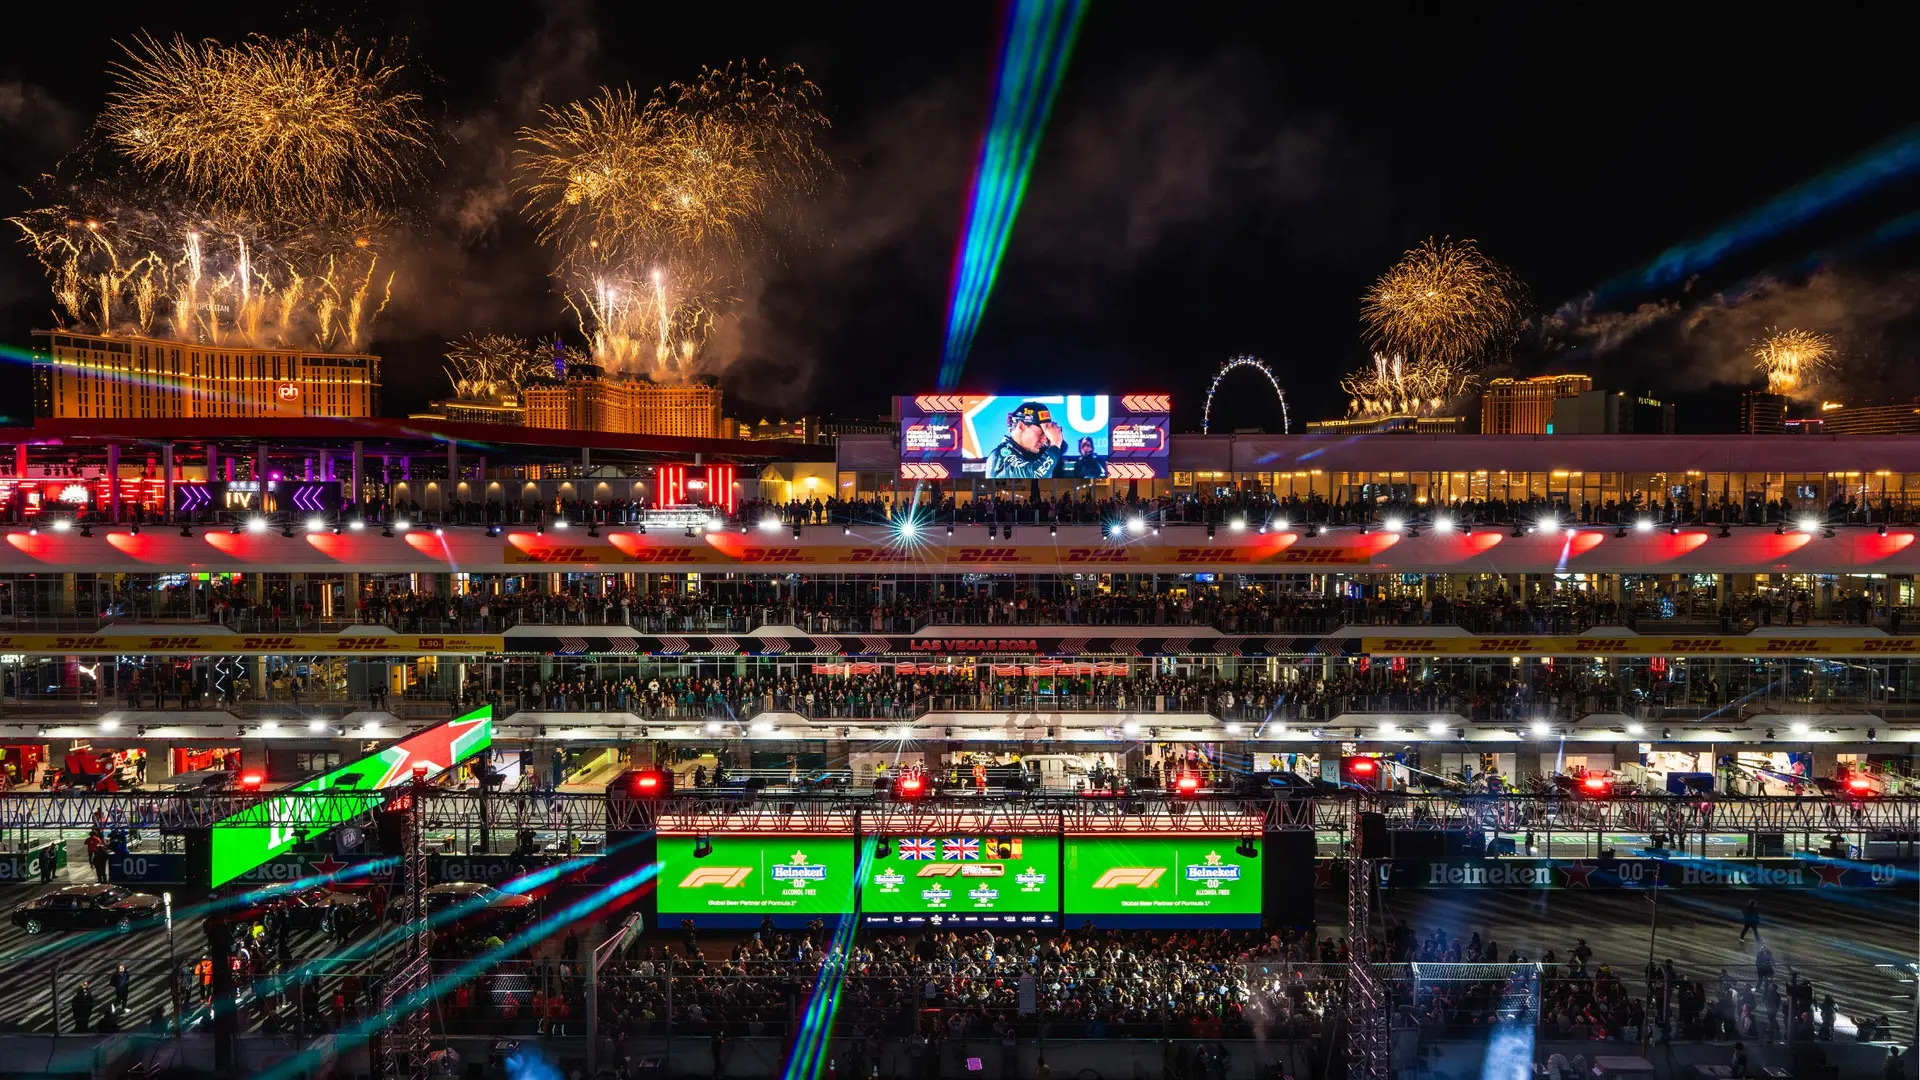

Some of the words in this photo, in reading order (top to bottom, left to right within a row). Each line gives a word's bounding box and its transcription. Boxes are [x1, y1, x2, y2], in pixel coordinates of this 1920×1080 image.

[280, 384, 298, 398] ph
[529, 549, 588, 562] DHL
[636, 549, 695, 562] DHL
[743, 549, 802, 562] DHL
[850, 549, 910, 562] DHL
[957, 549, 1020, 562] DHL
[1066, 549, 1129, 562] DHL
[1177, 549, 1238, 562] DHL
[1285, 549, 1347, 562] DHL
[56, 638, 108, 649] DHL
[150, 638, 202, 649] DHL
[243, 638, 295, 649] DHL
[337, 638, 389, 649] DHL
[911, 640, 941, 650] LAS
[944, 640, 997, 650] VEGAS
[999, 640, 1038, 650] 2024
[1383, 640, 1438, 651] DHL
[1480, 640, 1534, 651] DHL
[1576, 640, 1629, 651] DHL
[1671, 640, 1725, 651] DHL
[1768, 640, 1821, 651] DHL
[1863, 640, 1917, 651] DHL
[123, 857, 148, 876] 0.0
[775, 867, 823, 878] Heineken
[1189, 867, 1238, 878] Heineken
[1618, 862, 1643, 881] 0.0
[1871, 864, 1896, 882] 0.0
[678, 867, 753, 888] F1
[1092, 867, 1167, 888] F1
[1429, 862, 1551, 885] Heineken
[1682, 863, 1804, 885] Heineken
